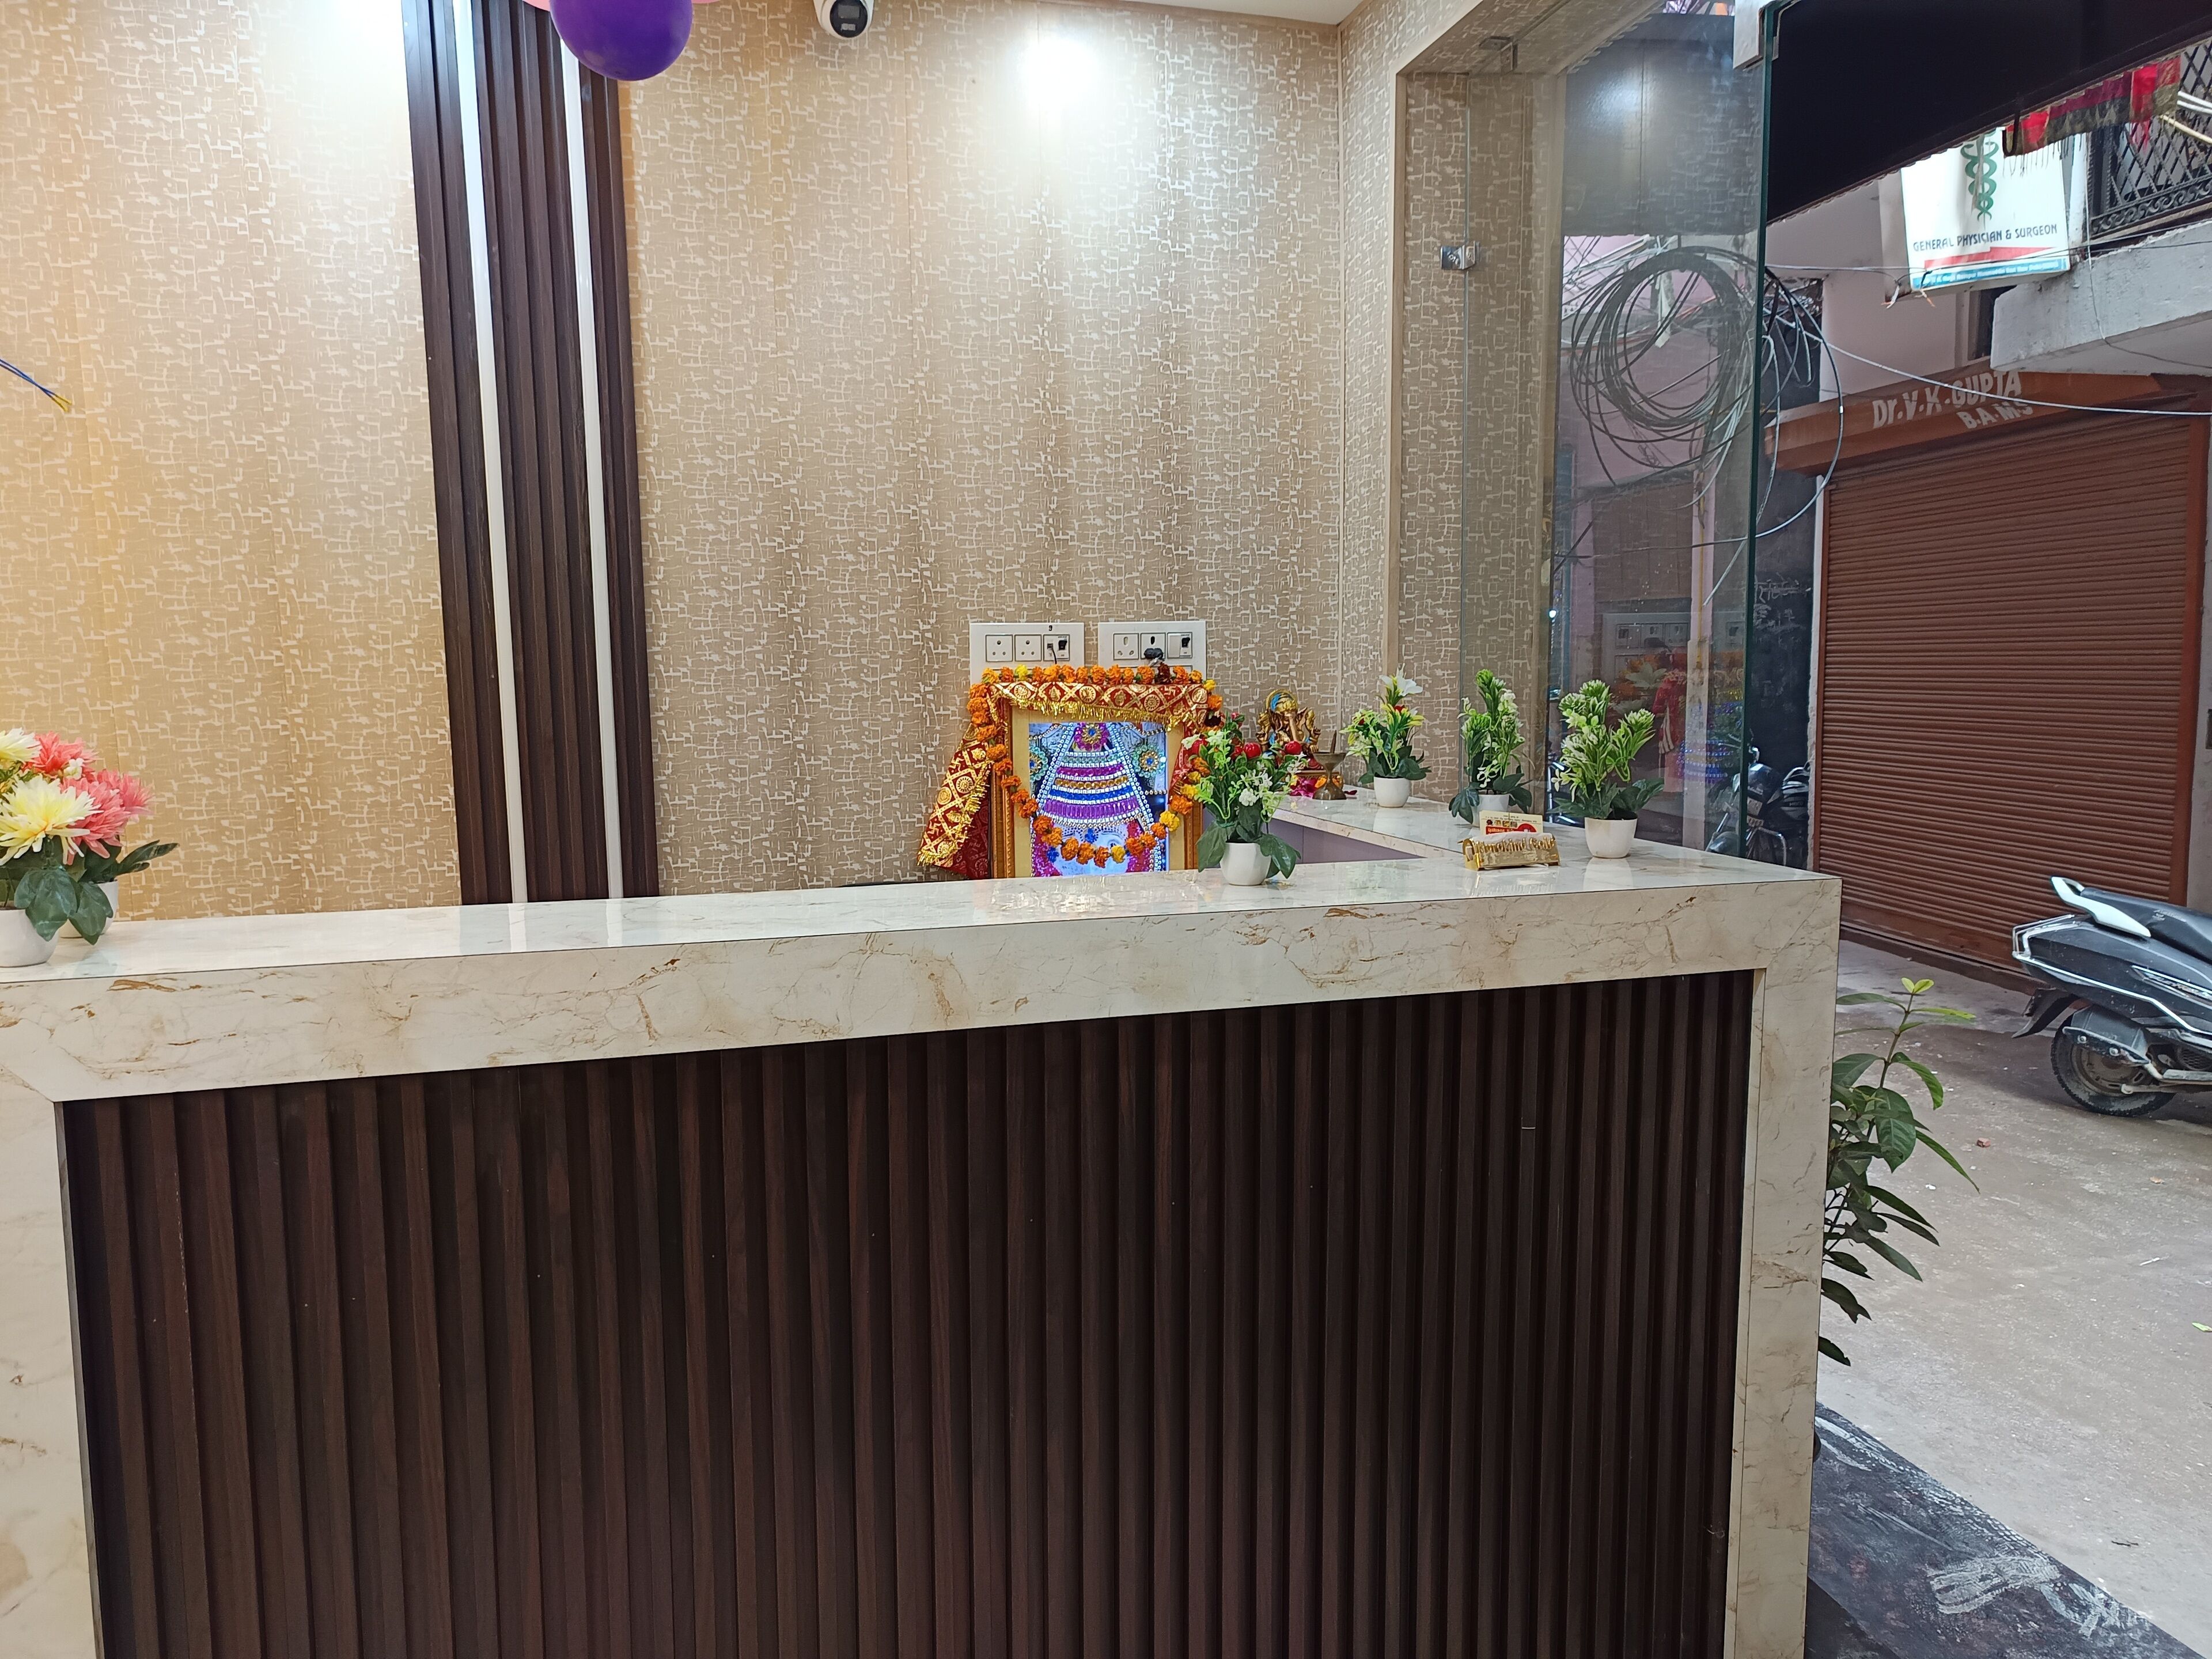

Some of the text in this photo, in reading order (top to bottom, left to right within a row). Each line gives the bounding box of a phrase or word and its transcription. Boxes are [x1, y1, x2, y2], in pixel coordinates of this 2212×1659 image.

[1914, 224, 2058, 252] GENERAL PHYSICIAN & SURGEON
